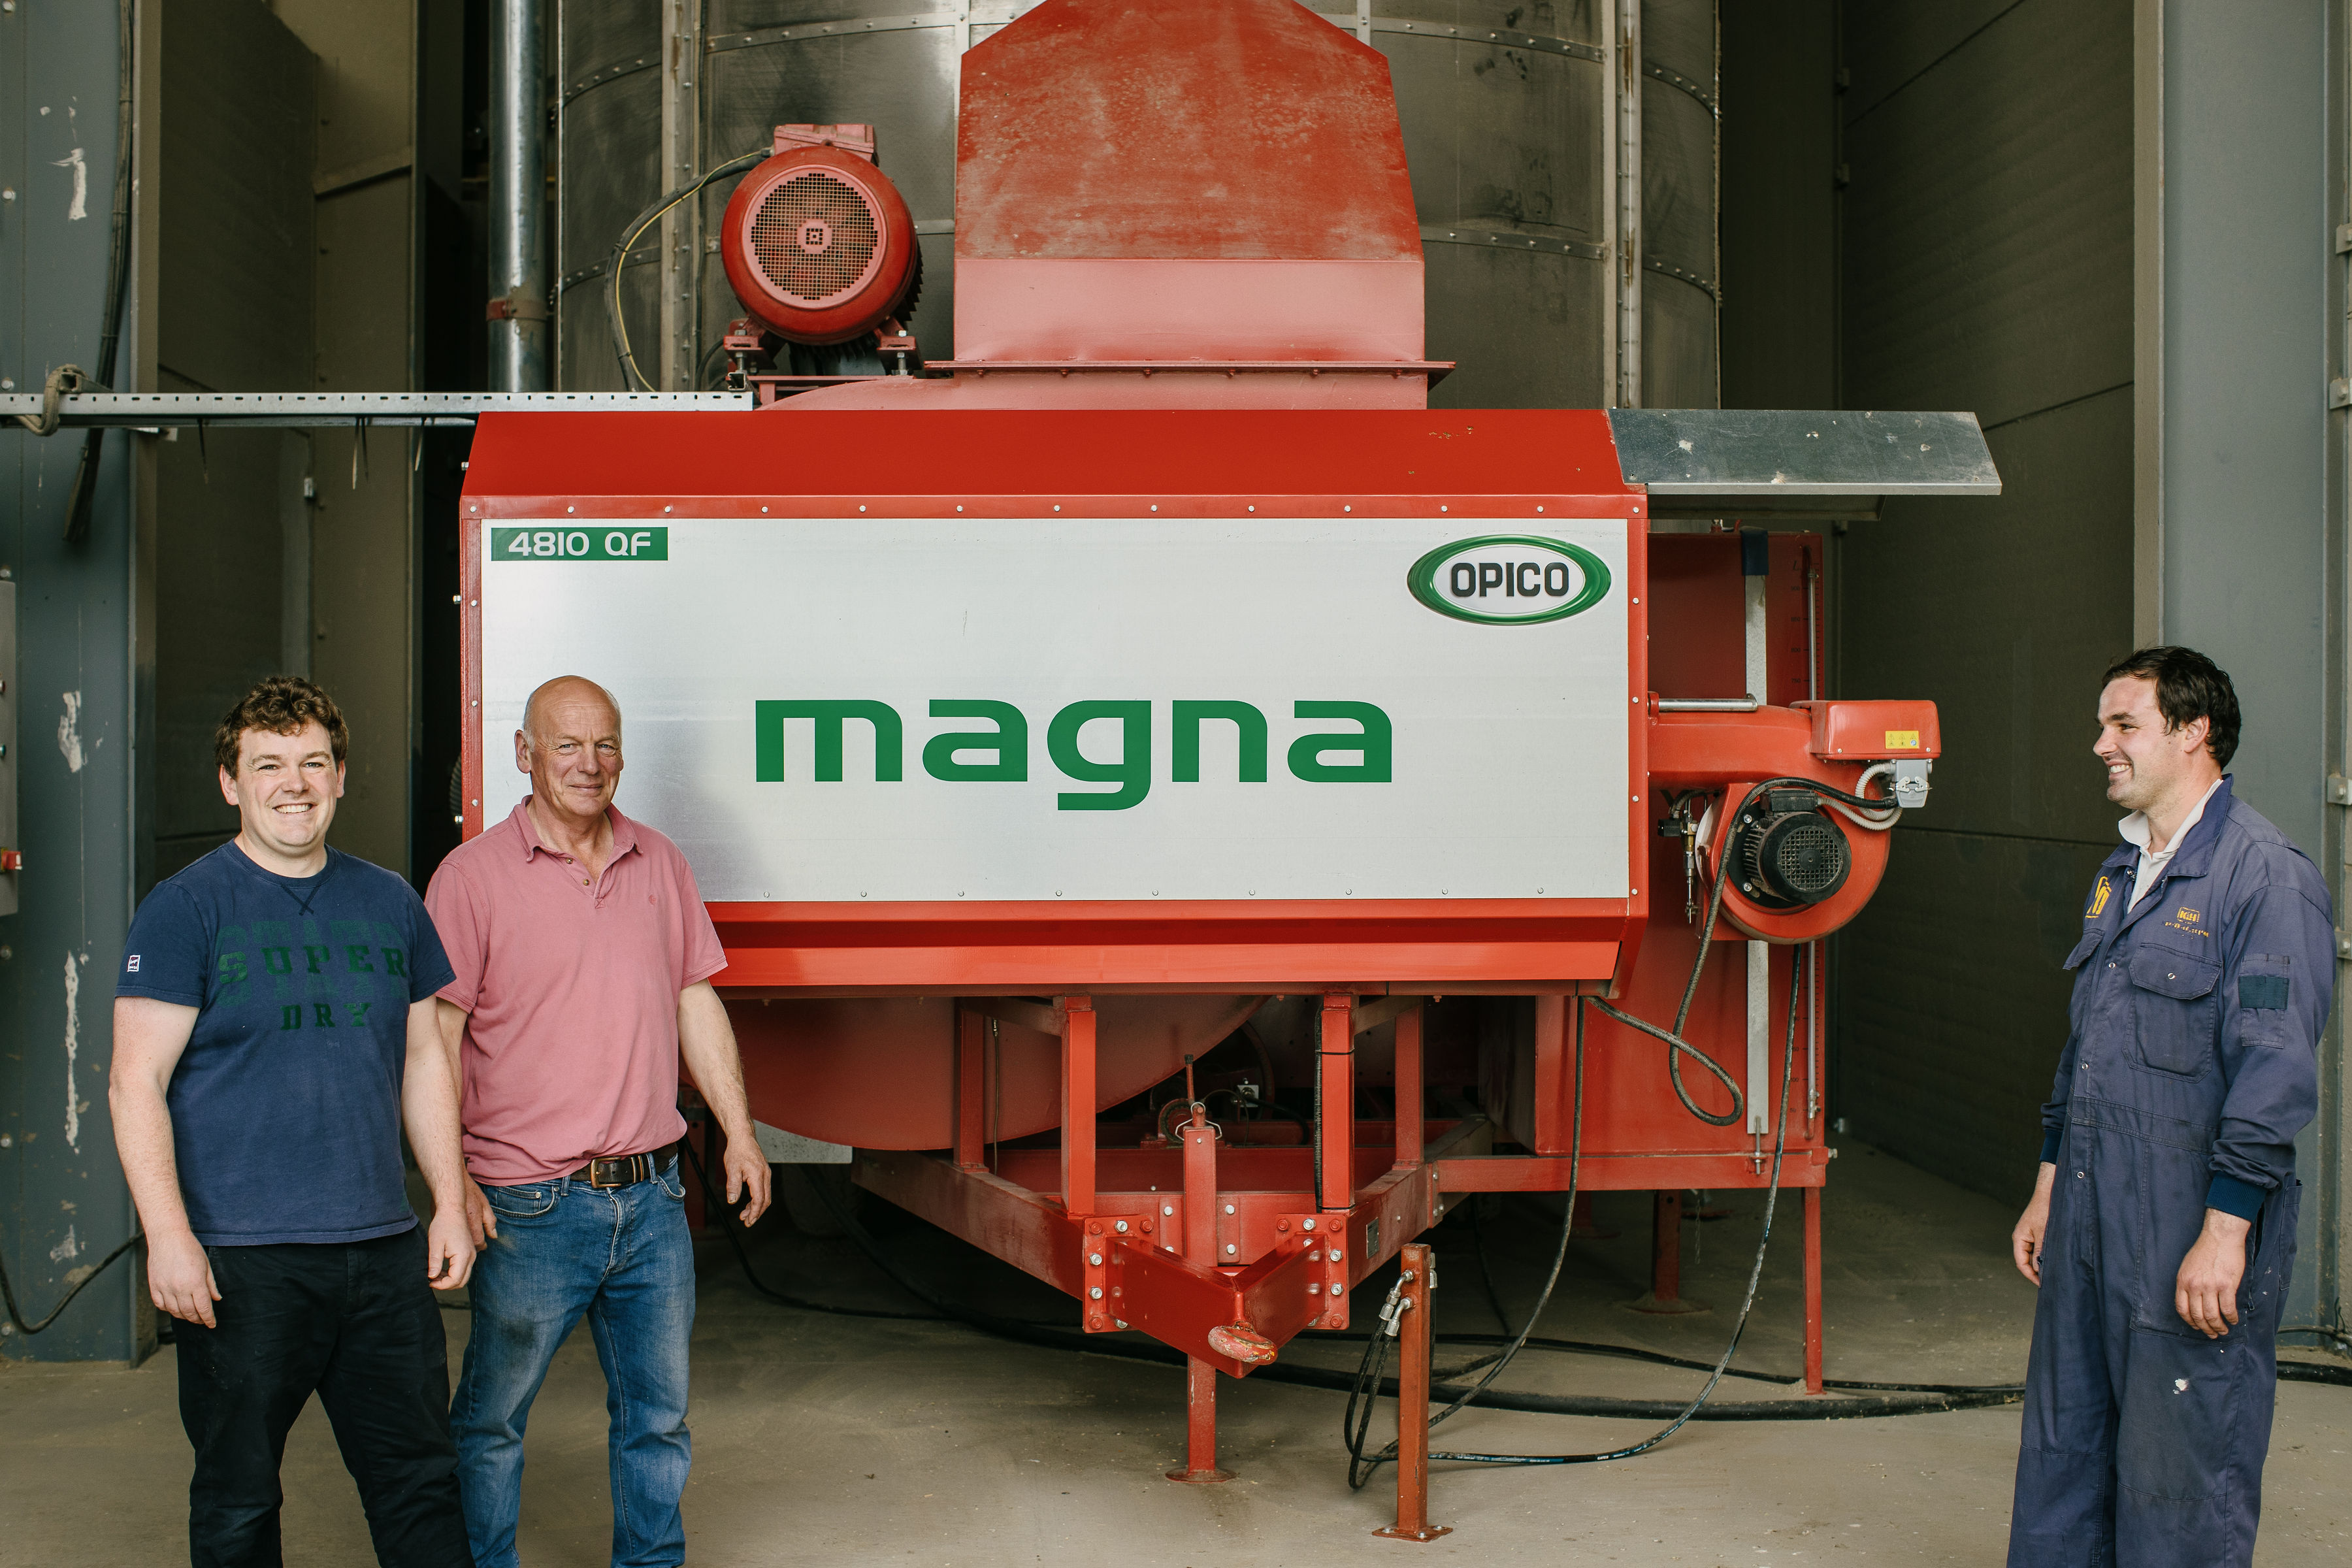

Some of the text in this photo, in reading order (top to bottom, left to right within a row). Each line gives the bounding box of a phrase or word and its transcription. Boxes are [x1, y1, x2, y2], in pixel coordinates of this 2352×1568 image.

[508, 532, 651, 557] 4810 QF
[1450, 562, 1569, 597] OPICO
[755, 699, 1392, 811] magna
[218, 944, 407, 985] SUPER
[280, 1002, 372, 1030] DRY
